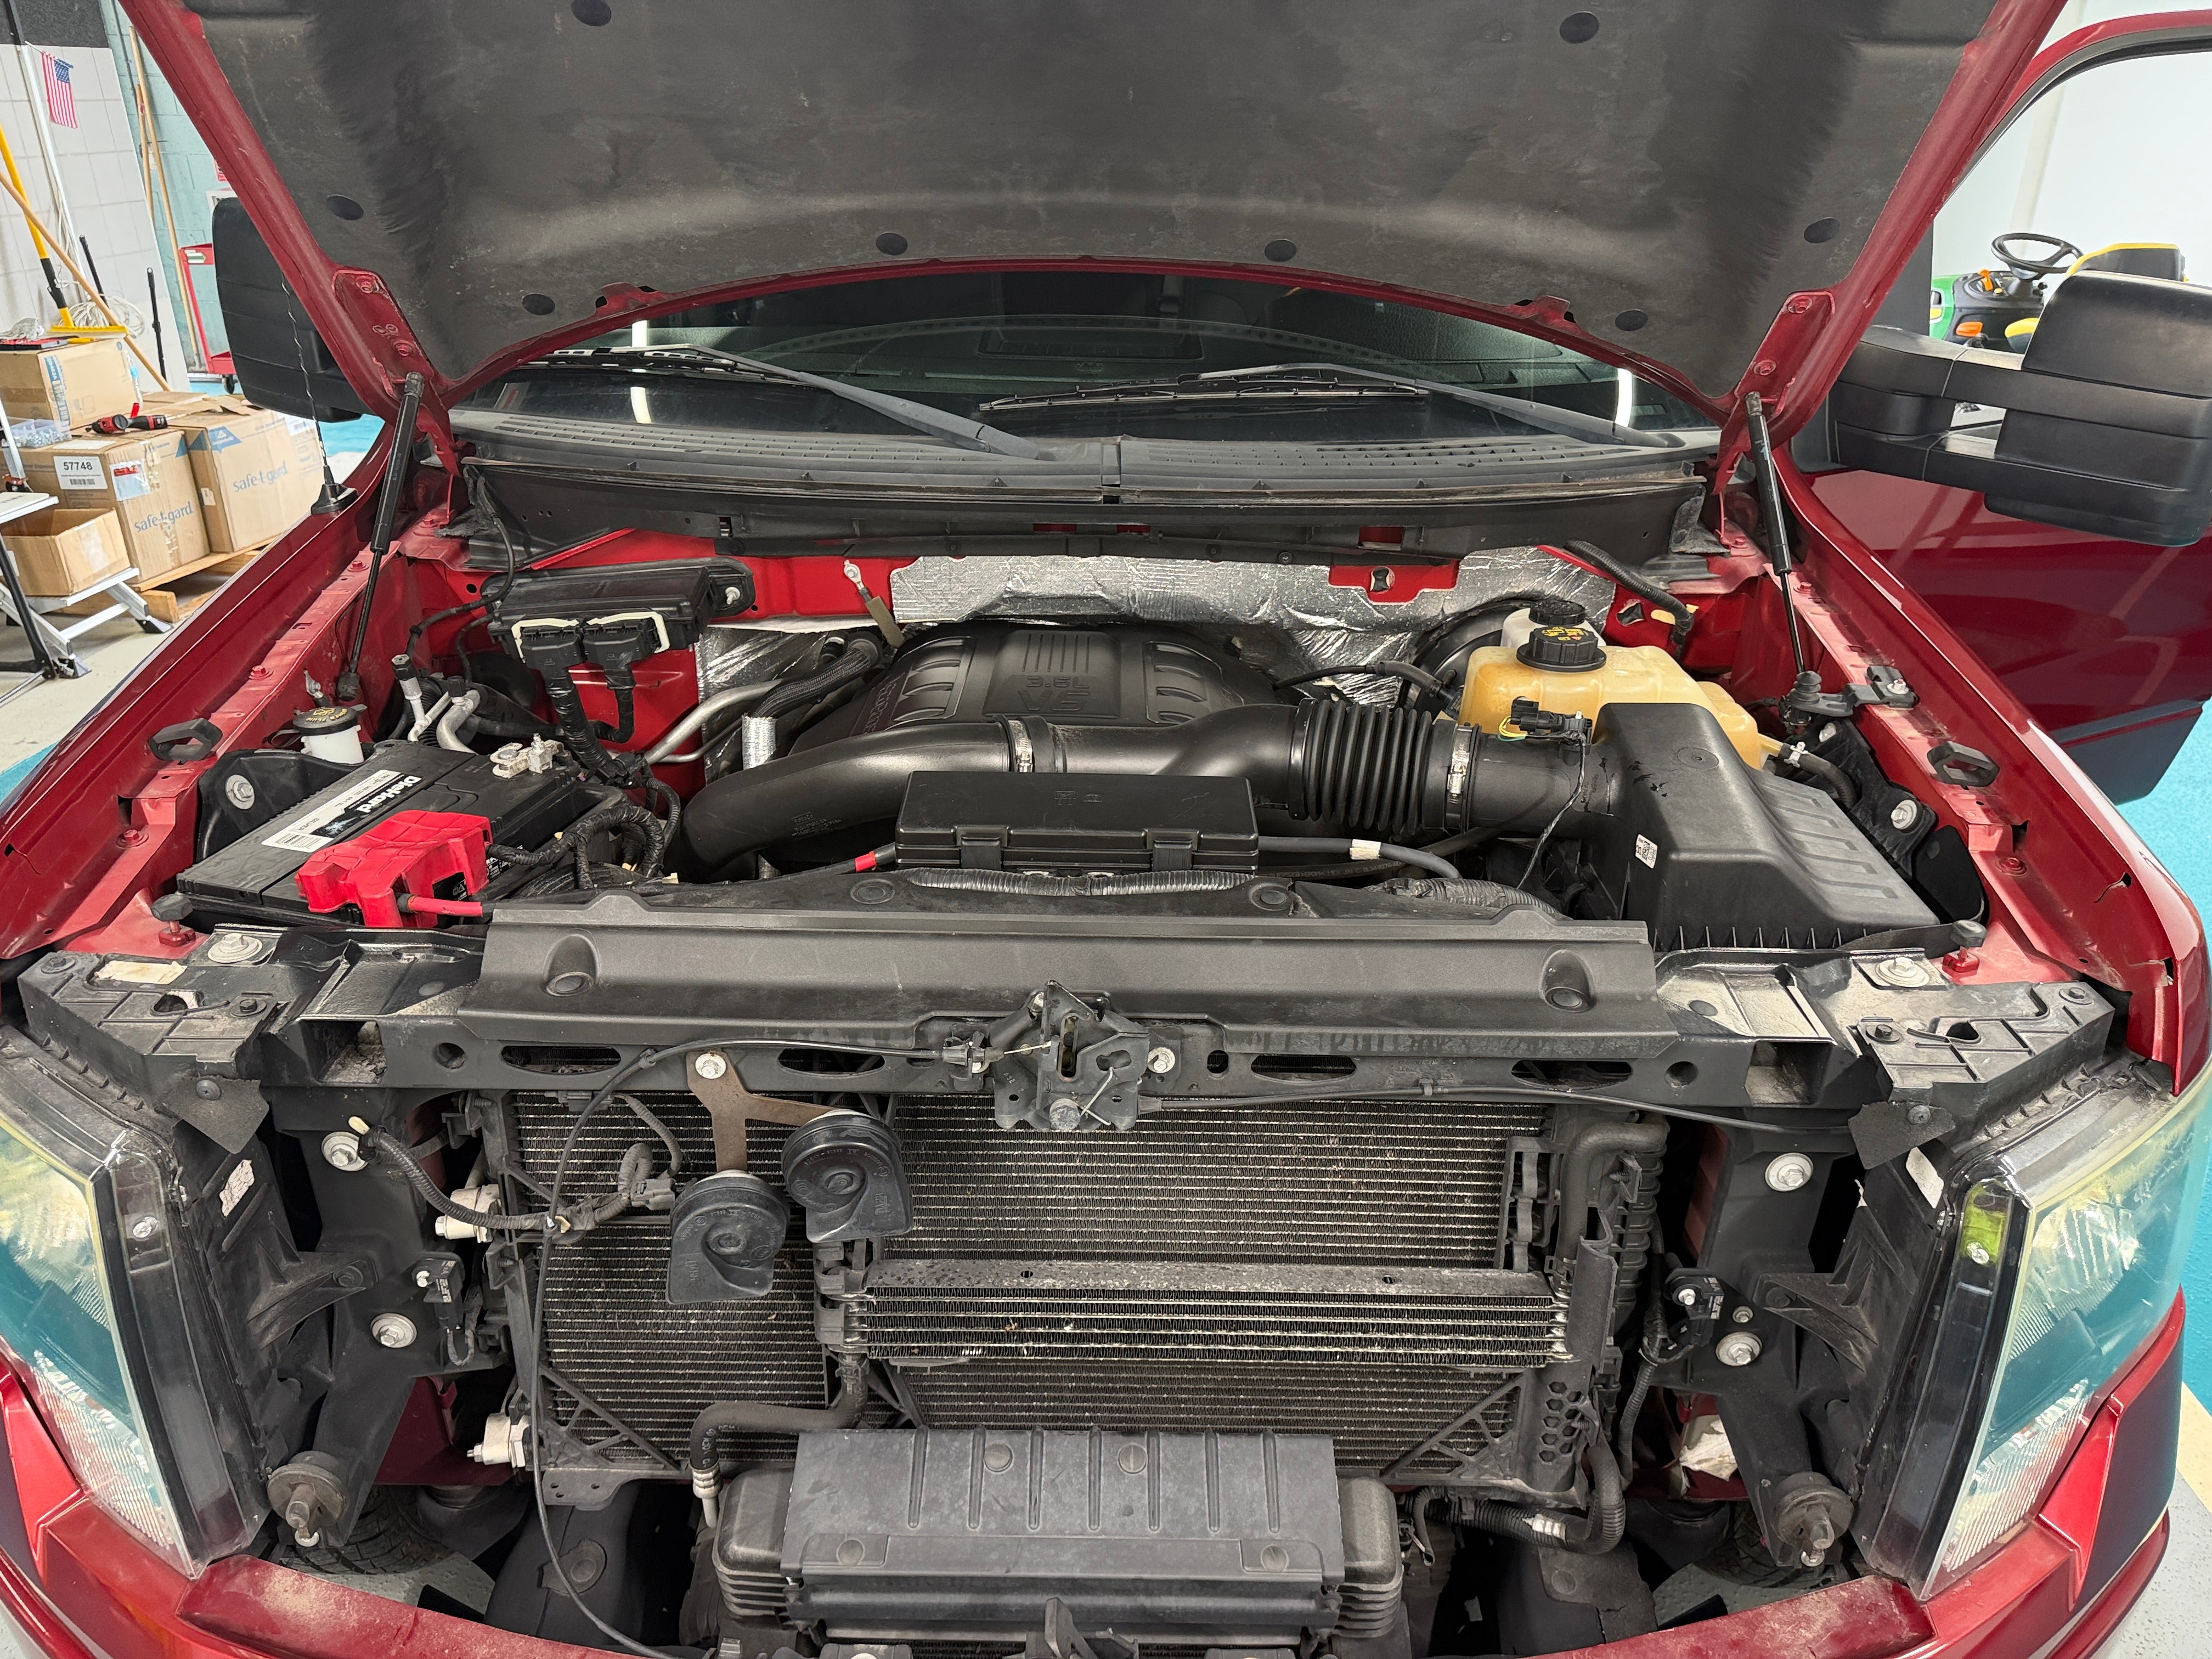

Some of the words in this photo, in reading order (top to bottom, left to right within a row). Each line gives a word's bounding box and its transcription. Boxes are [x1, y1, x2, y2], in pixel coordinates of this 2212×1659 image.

[63, 461, 93, 471] 57748
[1018, 689, 1090, 712] V6
[356, 775, 422, 813] DieHard
[297, 817, 320, 831] SILVER
